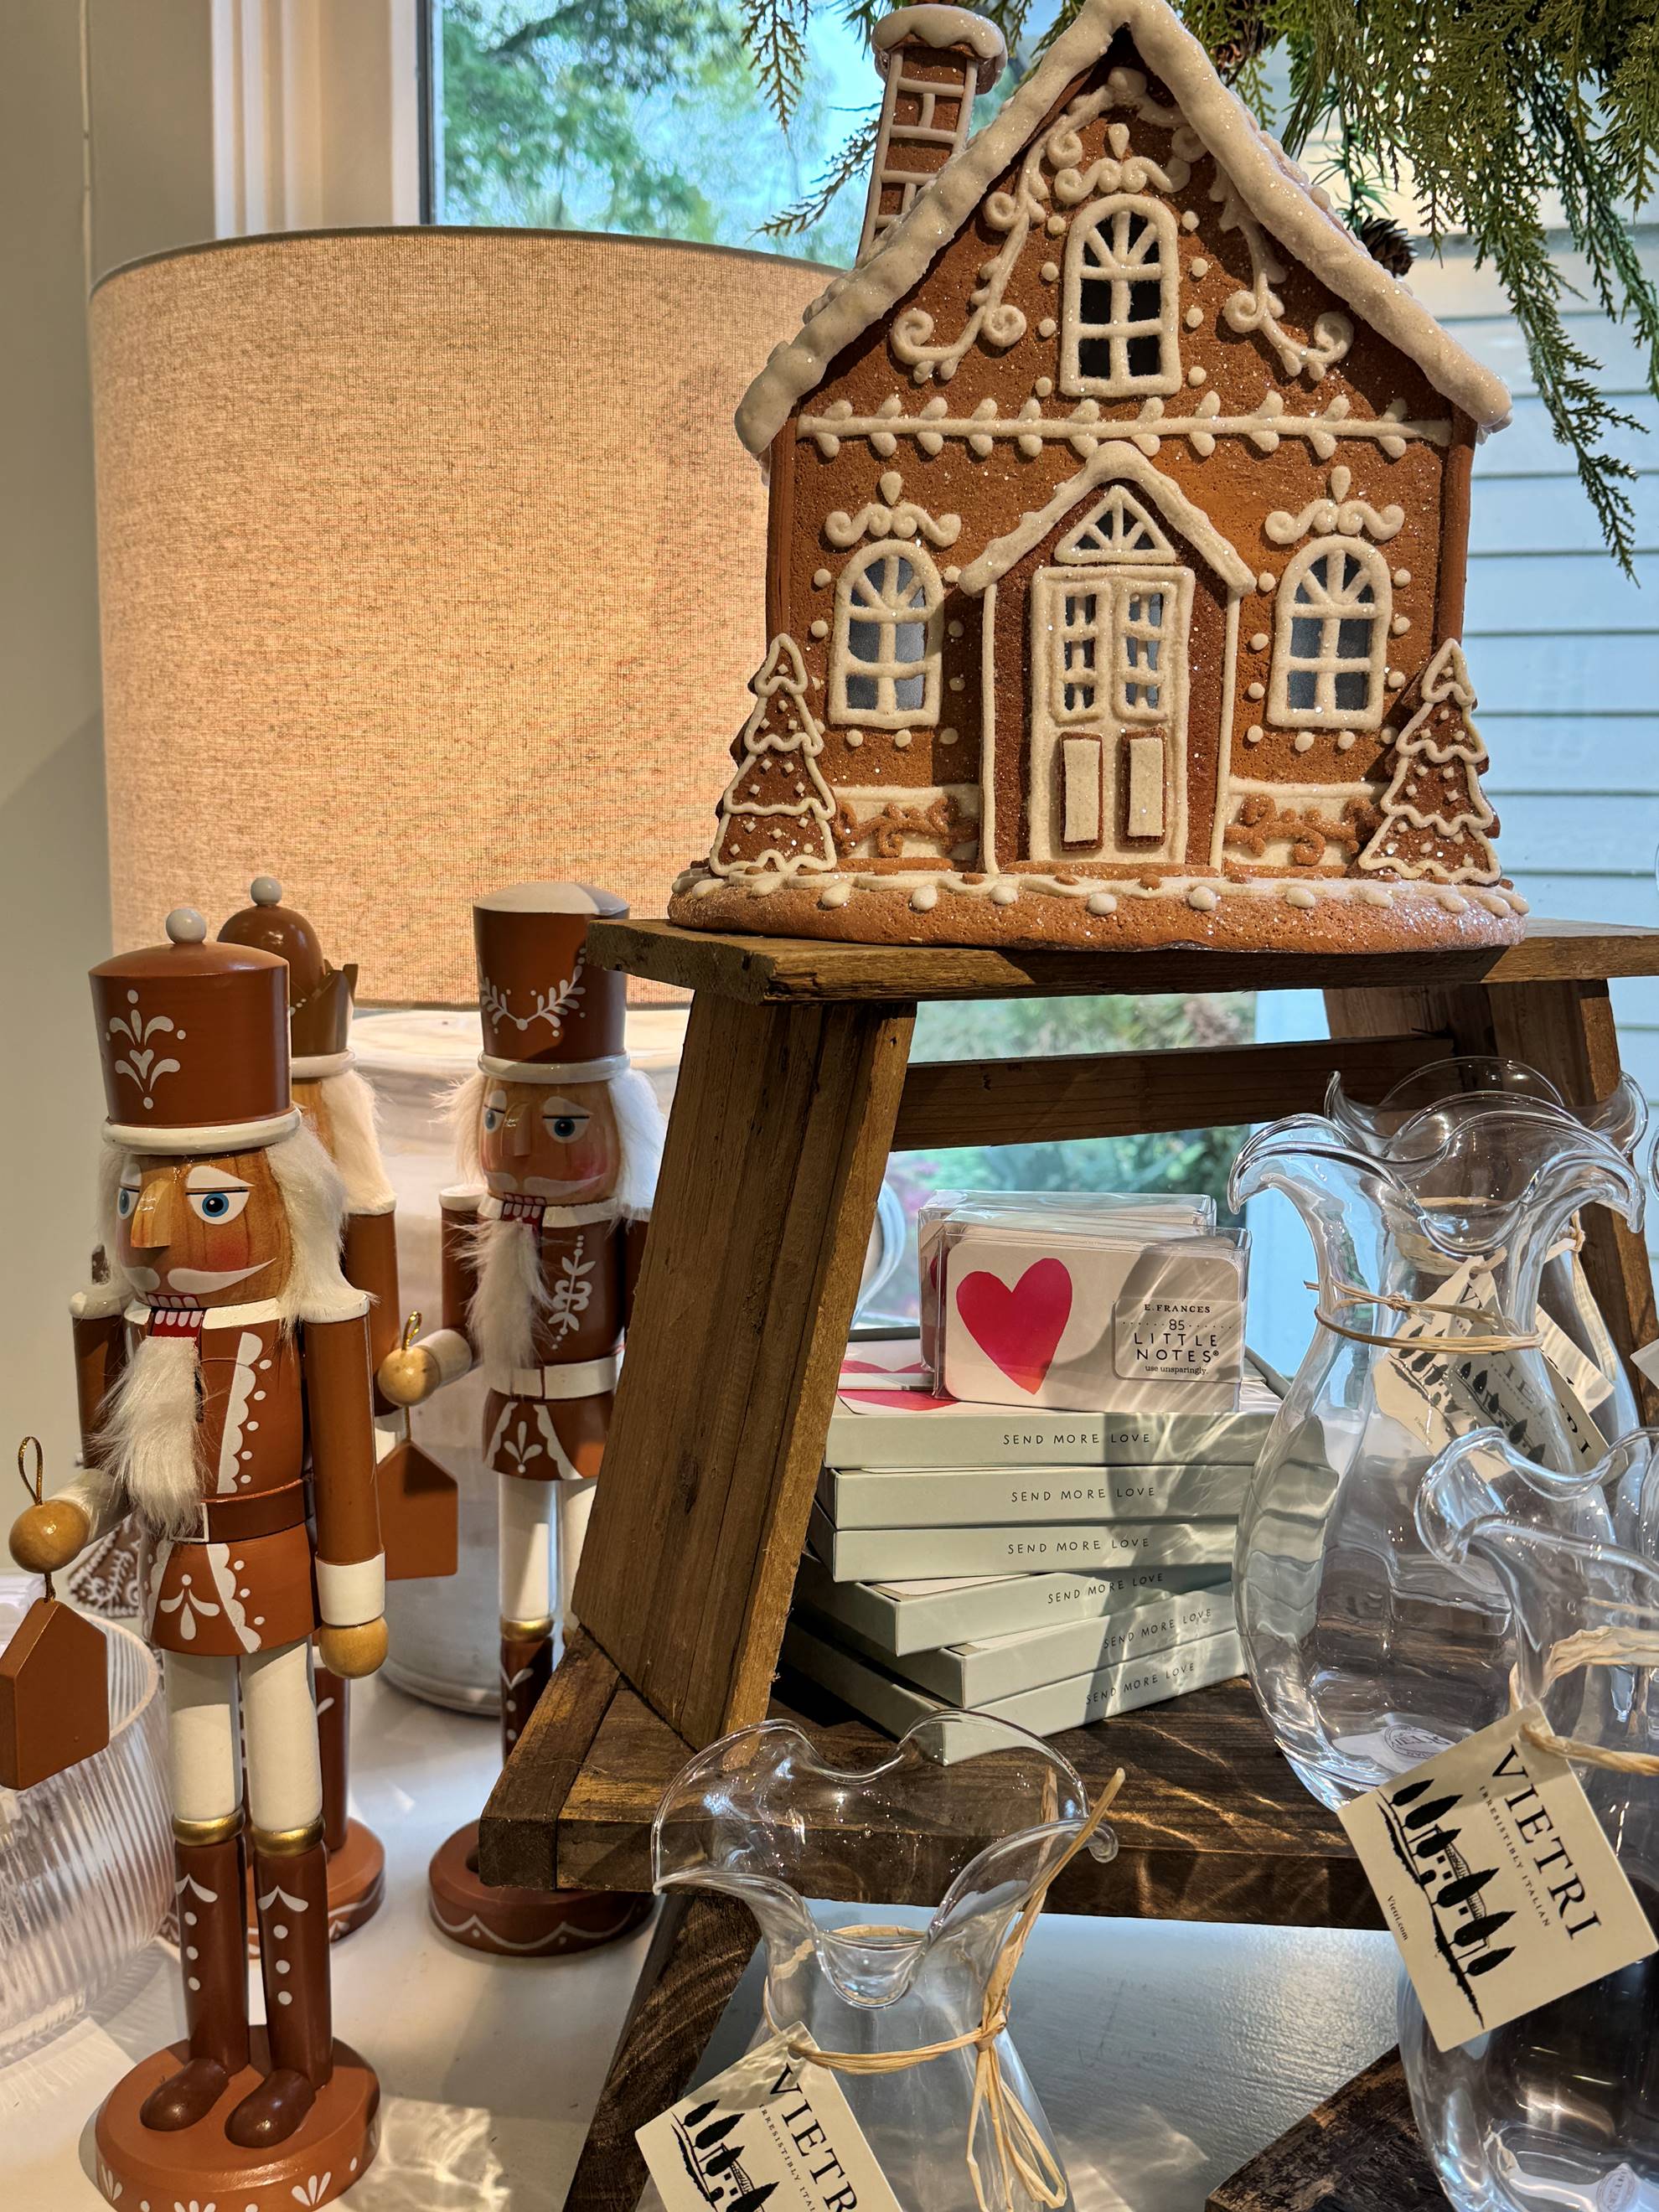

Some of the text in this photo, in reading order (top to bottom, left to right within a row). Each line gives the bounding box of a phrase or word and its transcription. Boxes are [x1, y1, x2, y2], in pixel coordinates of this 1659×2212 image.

[1134, 1332, 1217, 1346] LITTLE
[1169, 1319, 1185, 1331] 85
[1003, 1434, 1150, 1445] SEND MORE LOVE
[1011, 1487, 1155, 1502] SEND MORE LOVE
[1008, 1538, 1150, 1554] SEND MORE LOVE
[1047, 1573, 1163, 1604] SEND MORE LOVE
[1103, 1608, 1212, 1649] SEND MORE LOVE
[1086, 1662, 1195, 1705] SEND MORE LOVE
[1479, 1786, 1551, 1927] IRRESISTIBLY ITALIAN
[1491, 1744, 1602, 1941] VIETRI
[757, 2103, 802, 2180] IRRESISTIBLY
